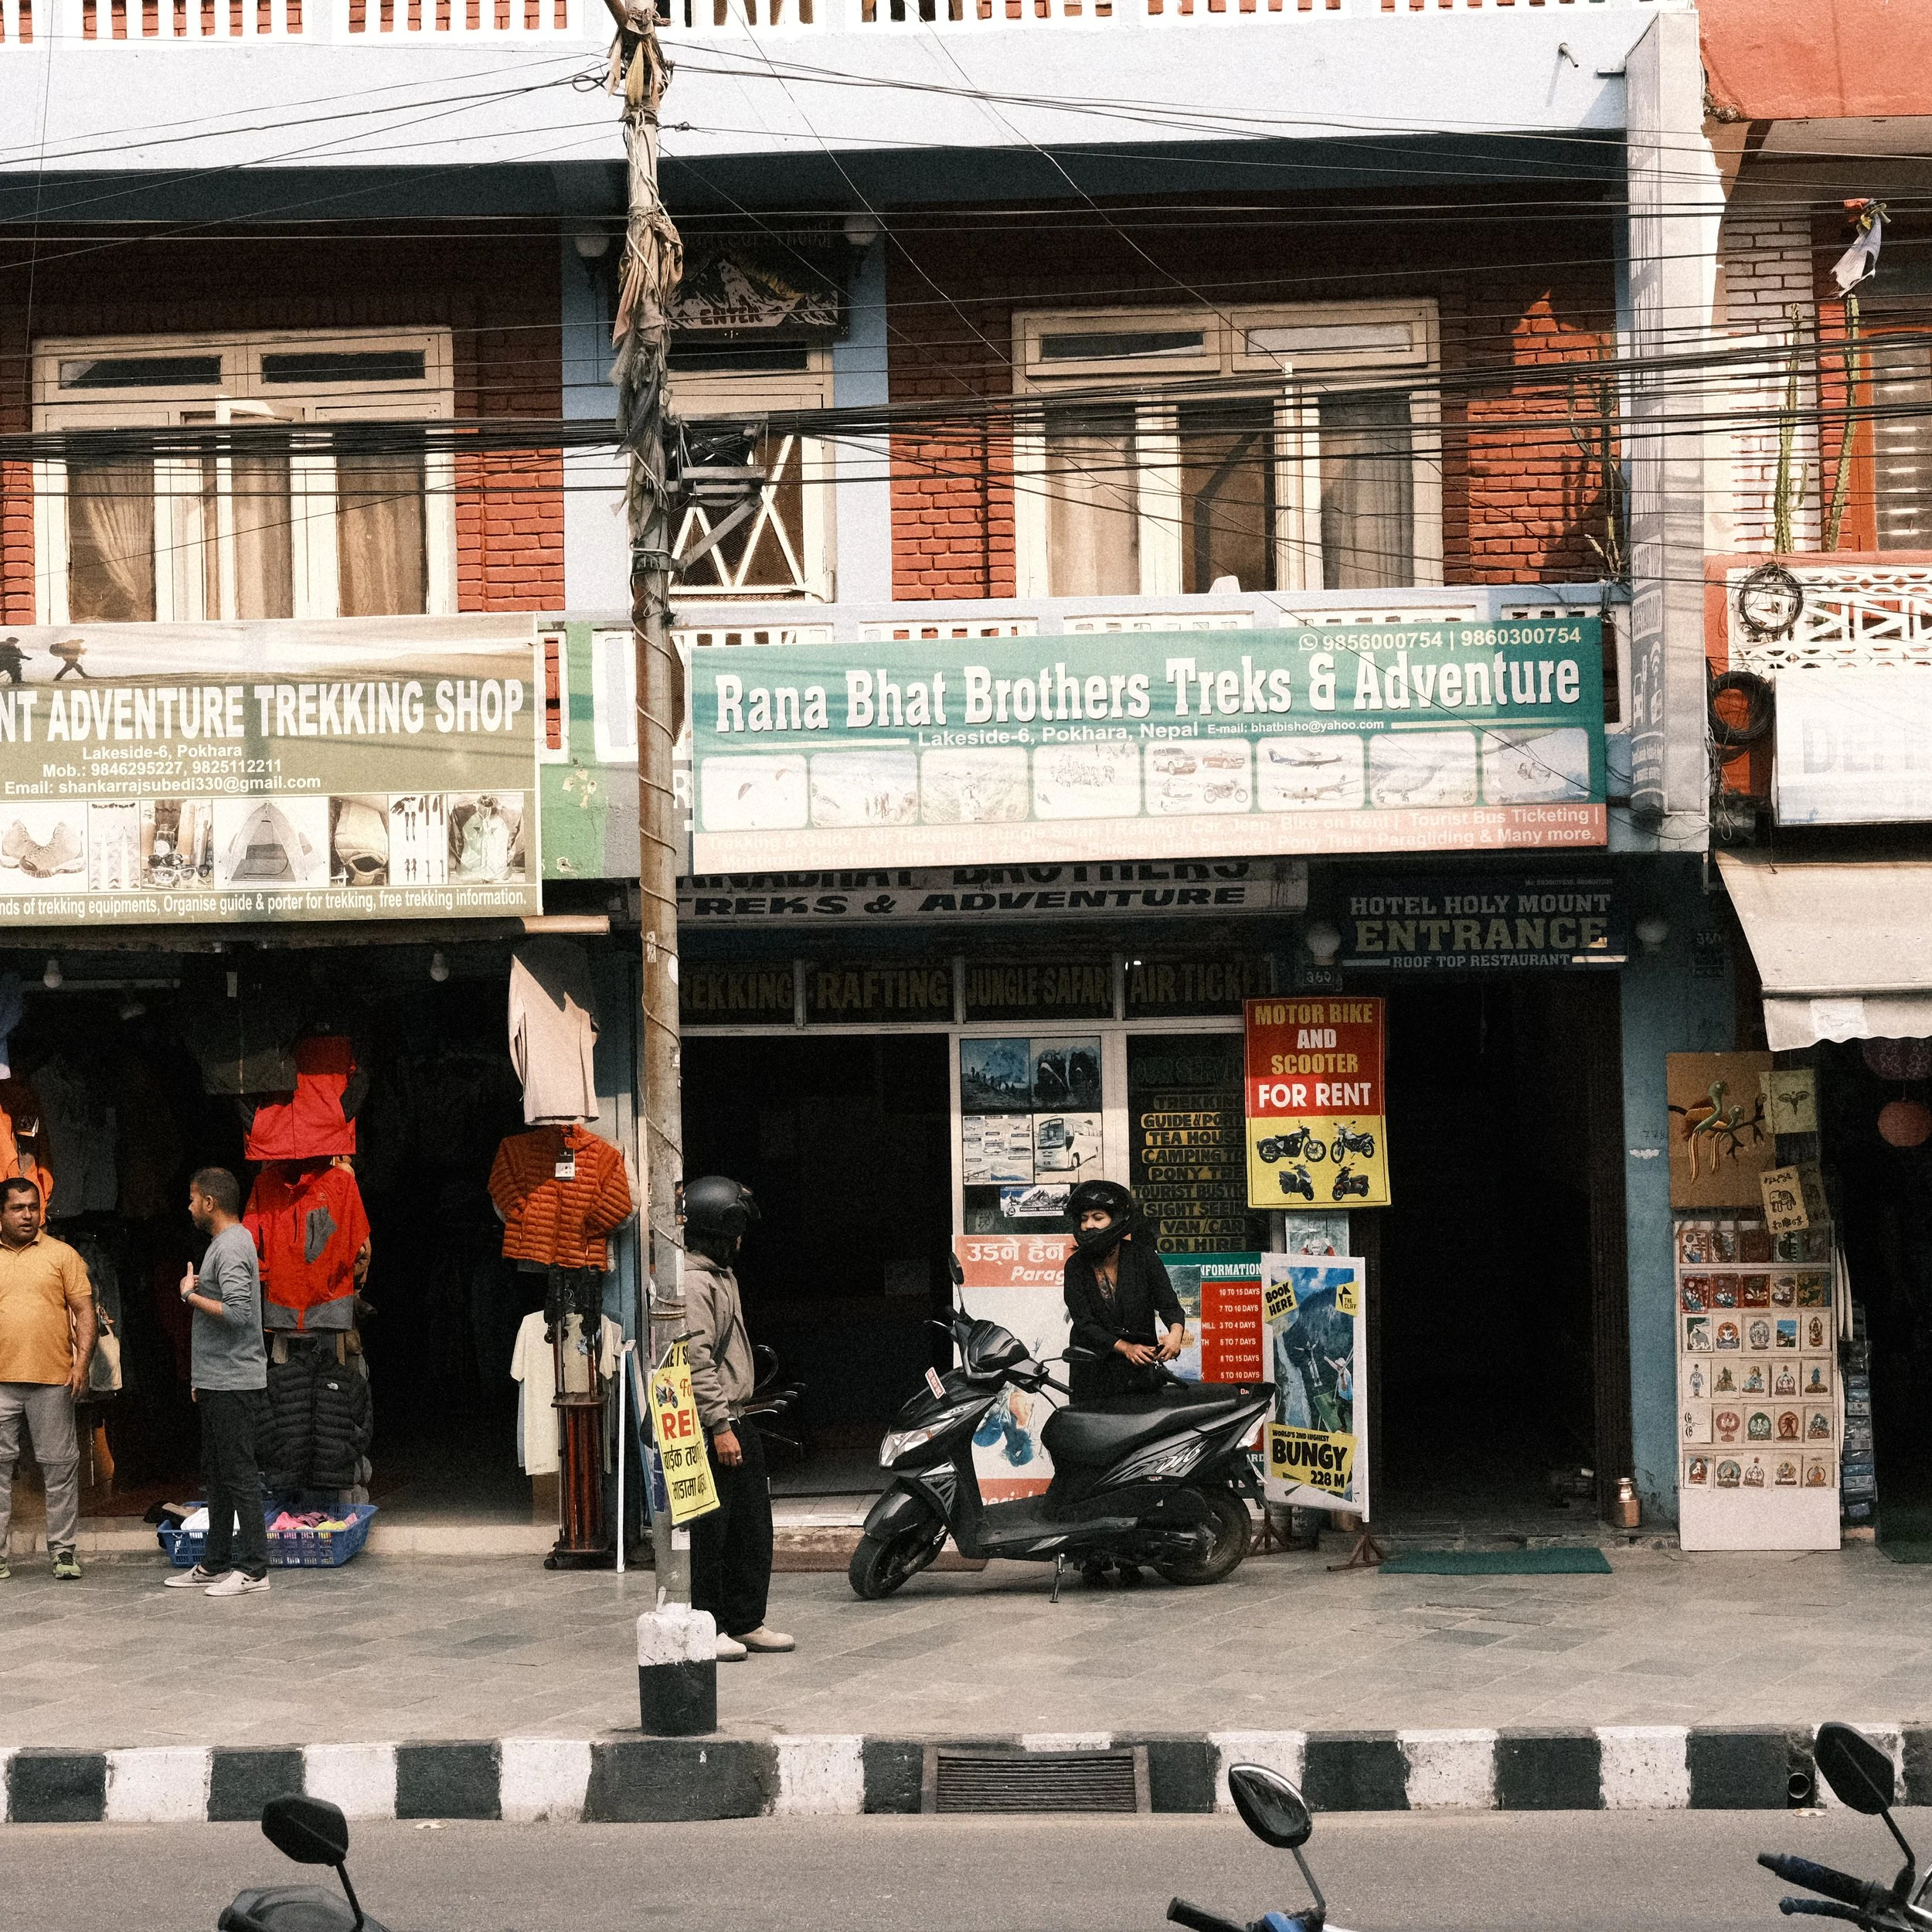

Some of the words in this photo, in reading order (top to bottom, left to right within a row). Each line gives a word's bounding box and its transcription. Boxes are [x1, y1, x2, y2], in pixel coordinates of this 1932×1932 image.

[700, 307, 763, 325] ENTER
[1322, 632, 1443, 651] 9856000754
[1461, 628, 1581, 647] 9860300754
[715, 674, 829, 733] Rana
[845, 668, 948, 729] Bhat
[963, 662, 1151, 725] Brothers
[1166, 655, 1291, 716] Treks
[1309, 652, 1336, 713] &
[1354, 651, 1581, 710] Adventure
[46, 685, 245, 743] ADVENTURE
[254, 680, 424, 738] TREKKING
[434, 679, 523, 734] SHOP
[919, 728, 1035, 747] Lakeside-6,
[1042, 725, 1133, 742] Pokhara,
[1141, 723, 1198, 742] Nepal
[1207, 723, 1247, 734] E-mail:
[1251, 720, 1384, 733] bhatbisho@yahoo.com
[83, 744, 172, 760] Lakeside-6,
[177, 743, 242, 758] Pokhara
[43, 764, 86, 777] Mob.:
[91, 761, 187, 777] 9846295227,
[192, 759, 282, 775] 9825112211
[5, 781, 53, 795] Email:
[59, 774, 321, 796] shankarrajsubedi330@gmail.com
[1281, 816, 1320, 830] Bike
[1323, 818, 1344, 829] on
[1349, 814, 1389, 827] Rent
[1410, 811, 1468, 826] Tourist
[1473, 810, 1506, 824] Bus
[1512, 808, 1590, 825] Ticketing
[1278, 835, 1321, 850] Pony
[1327, 834, 1361, 847] Trek
[1378, 831, 1475, 848] Paragliding
[1480, 829, 1492, 843] &
[1498, 828, 1543, 844] Many
[1548, 829, 1596, 842] more.
[23, 900, 36, 915] of
[38, 897, 85, 918] trekking
[88, 896, 160, 917] equipments,
[163, 895, 216, 916] Organise
[219, 893, 253, 916] guide
[256, 893, 265, 910] &
[267, 893, 303, 914] porter
[305, 893, 323, 909] for
[325, 891, 376, 912] trekking,
[379, 890, 402, 906] free
[405, 889, 452, 910] trekking
[456, 888, 526, 906] information.
[864, 893, 897, 914] &
[917, 886, 1246, 912] ADVENTURE
[1351, 896, 1437, 916] HOTEL
[1444, 895, 1510, 914] HOLY
[1518, 894, 1611, 913] MOUNT
[1355, 917, 1608, 952] ENTRANCE
[1393, 956, 1432, 968] ROOF
[1436, 955, 1466, 967] TOP
[1471, 954, 1571, 967] RESTAURANT
[680, 973, 794, 1009] REKKING
[817, 970, 949, 1009] RAFTING
[967, 967, 1038, 1007] JUNGLE
[1130, 964, 1177, 1004] AIR
[1255, 1004, 1325, 1026] MOTOR
[1329, 1004, 1373, 1024] BIKE
[1297, 1029, 1337, 1049] AND
[1270, 1053, 1359, 1075] SCOOTER
[1258, 1083, 1307, 1108] FOR
[1315, 1083, 1372, 1107] RENT
[1149, 1131, 1182, 1145] TEA
[1144, 1149, 1221, 1163] CAMPING
[1151, 1168, 1201, 1181] PONY
[1135, 1185, 1193, 1199] TOURIST
[1146, 1202, 1199, 1216] SIGHT
[1159, 1239, 1189, 1252] ON
[1194, 1238, 1243, 1251] HIRE
[1265, 1281, 1291, 1304] BOOK
[1268, 1295, 1294, 1317] HERE
[662, 1409, 696, 1440] RE
[1273, 1430, 1295, 1438] WORLD'S
[1296, 1431, 1307, 1440] 2ND
[1308, 1434, 1329, 1442] HIGHEST
[1272, 1438, 1348, 1471] BUNGY
[1310, 1470, 1332, 1486] 228
[1334, 1473, 1345, 1488] M
